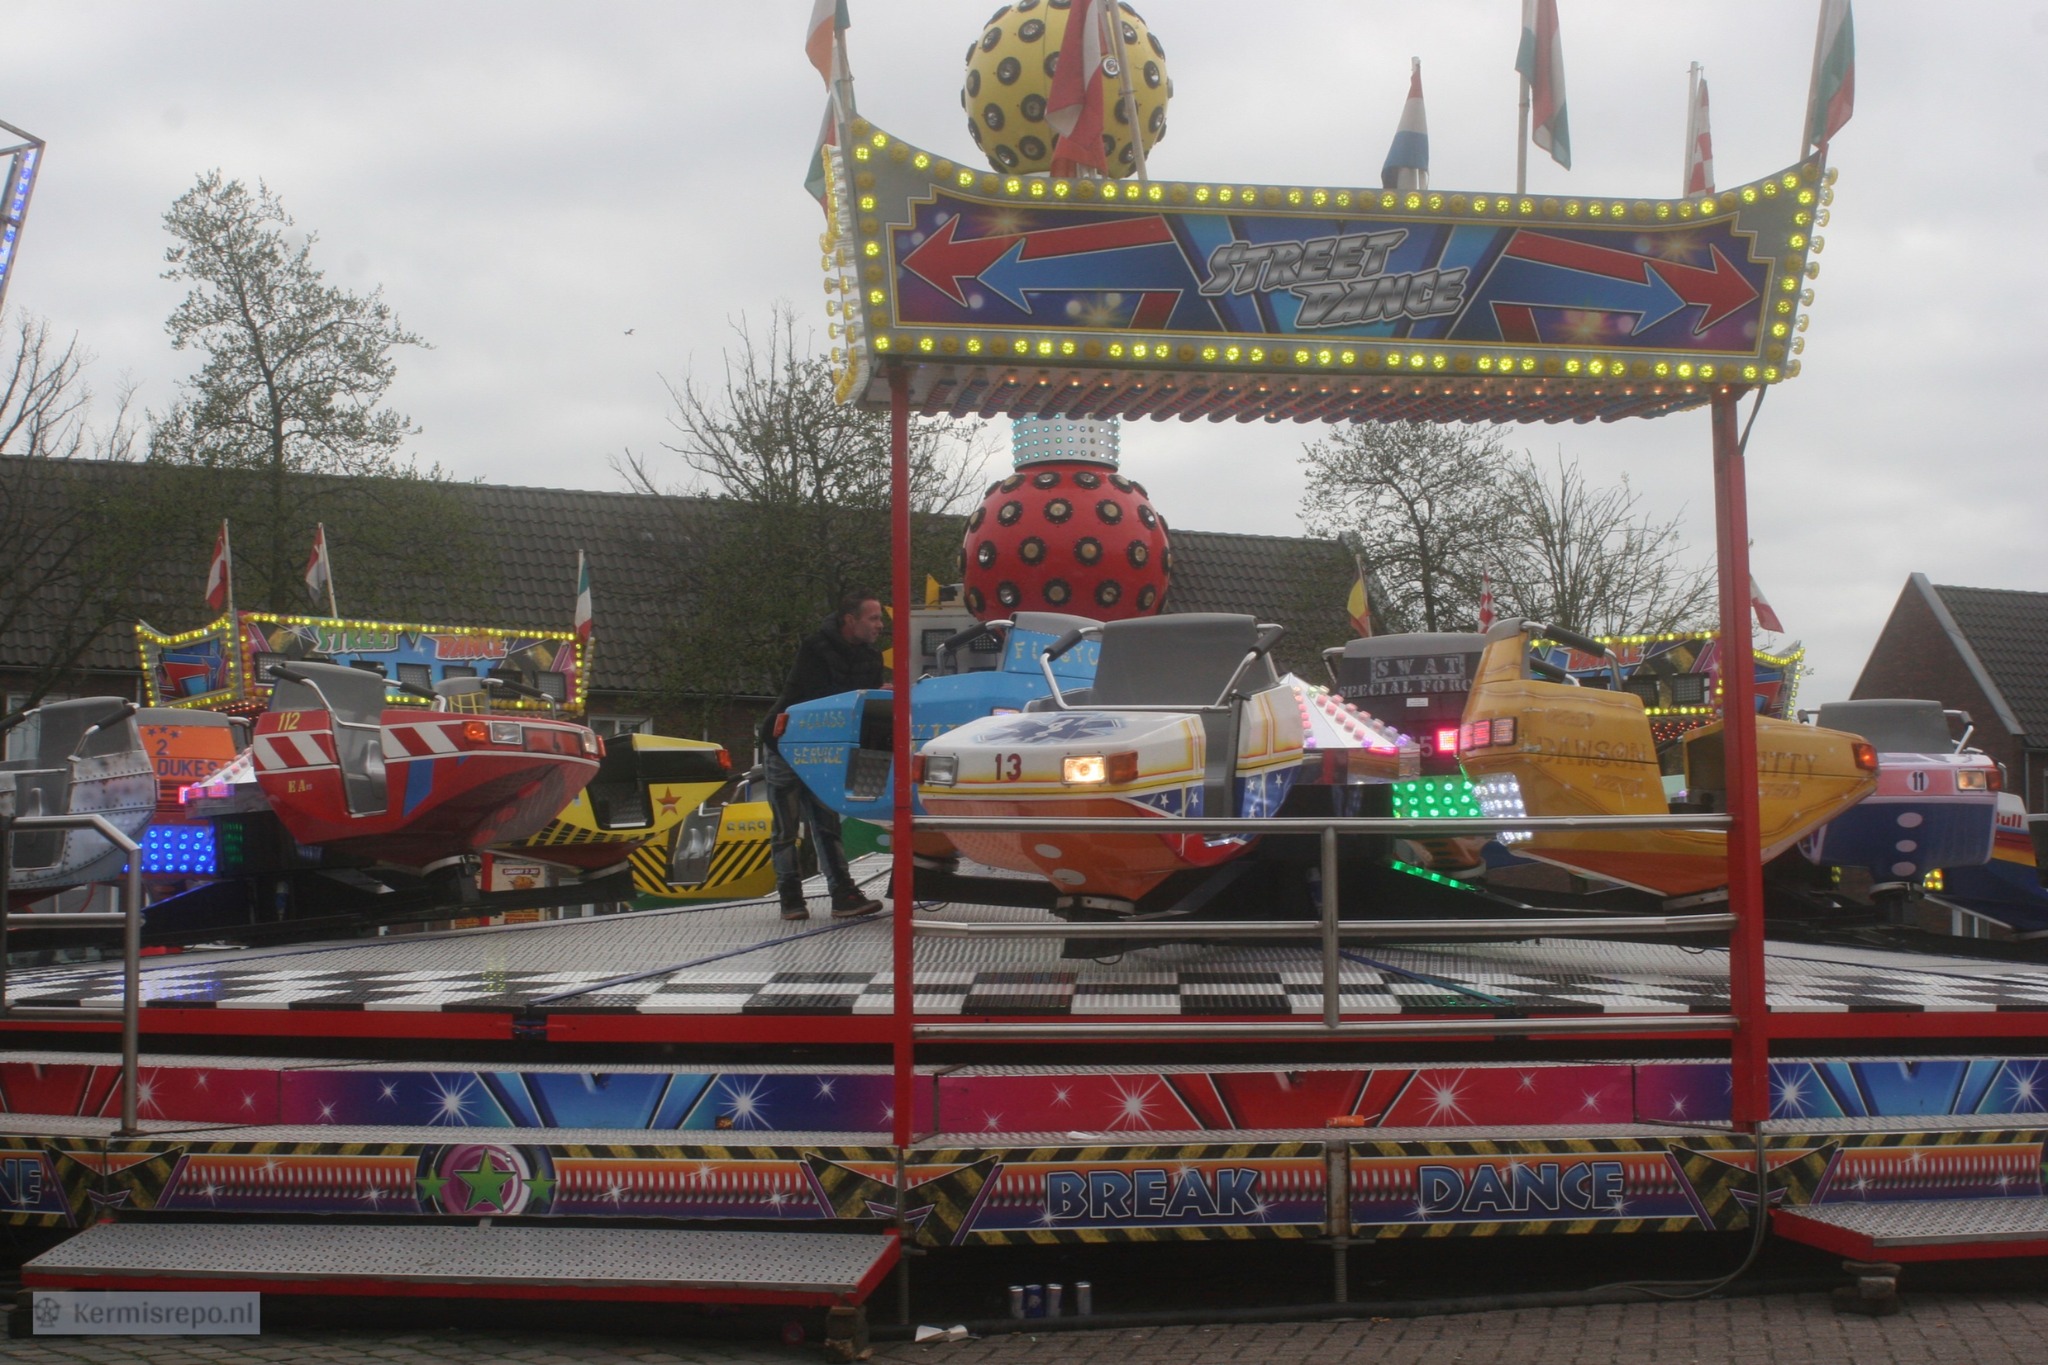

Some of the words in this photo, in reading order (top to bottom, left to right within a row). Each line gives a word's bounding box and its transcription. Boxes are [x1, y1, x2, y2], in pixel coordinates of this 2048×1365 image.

[1199, 229, 1408, 295] STREET
[1293, 268, 1469, 328] DANCE
[314, 627, 401, 653] STREET
[436, 634, 508, 660] DANCE
[1377, 657, 1459, 677] SWAT
[1338, 680, 1413, 698] SPECIAL
[278, 712, 301, 731] 112
[155, 739, 168, 756] 2
[794, 747, 843, 765] SERVICE
[156, 759, 219, 778] DUKES
[995, 753, 1022, 783] 13
[1912, 771, 1924, 791] 11
[1047, 1168, 1258, 1219] BREAK
[1419, 1161, 1624, 1213] DANCE
